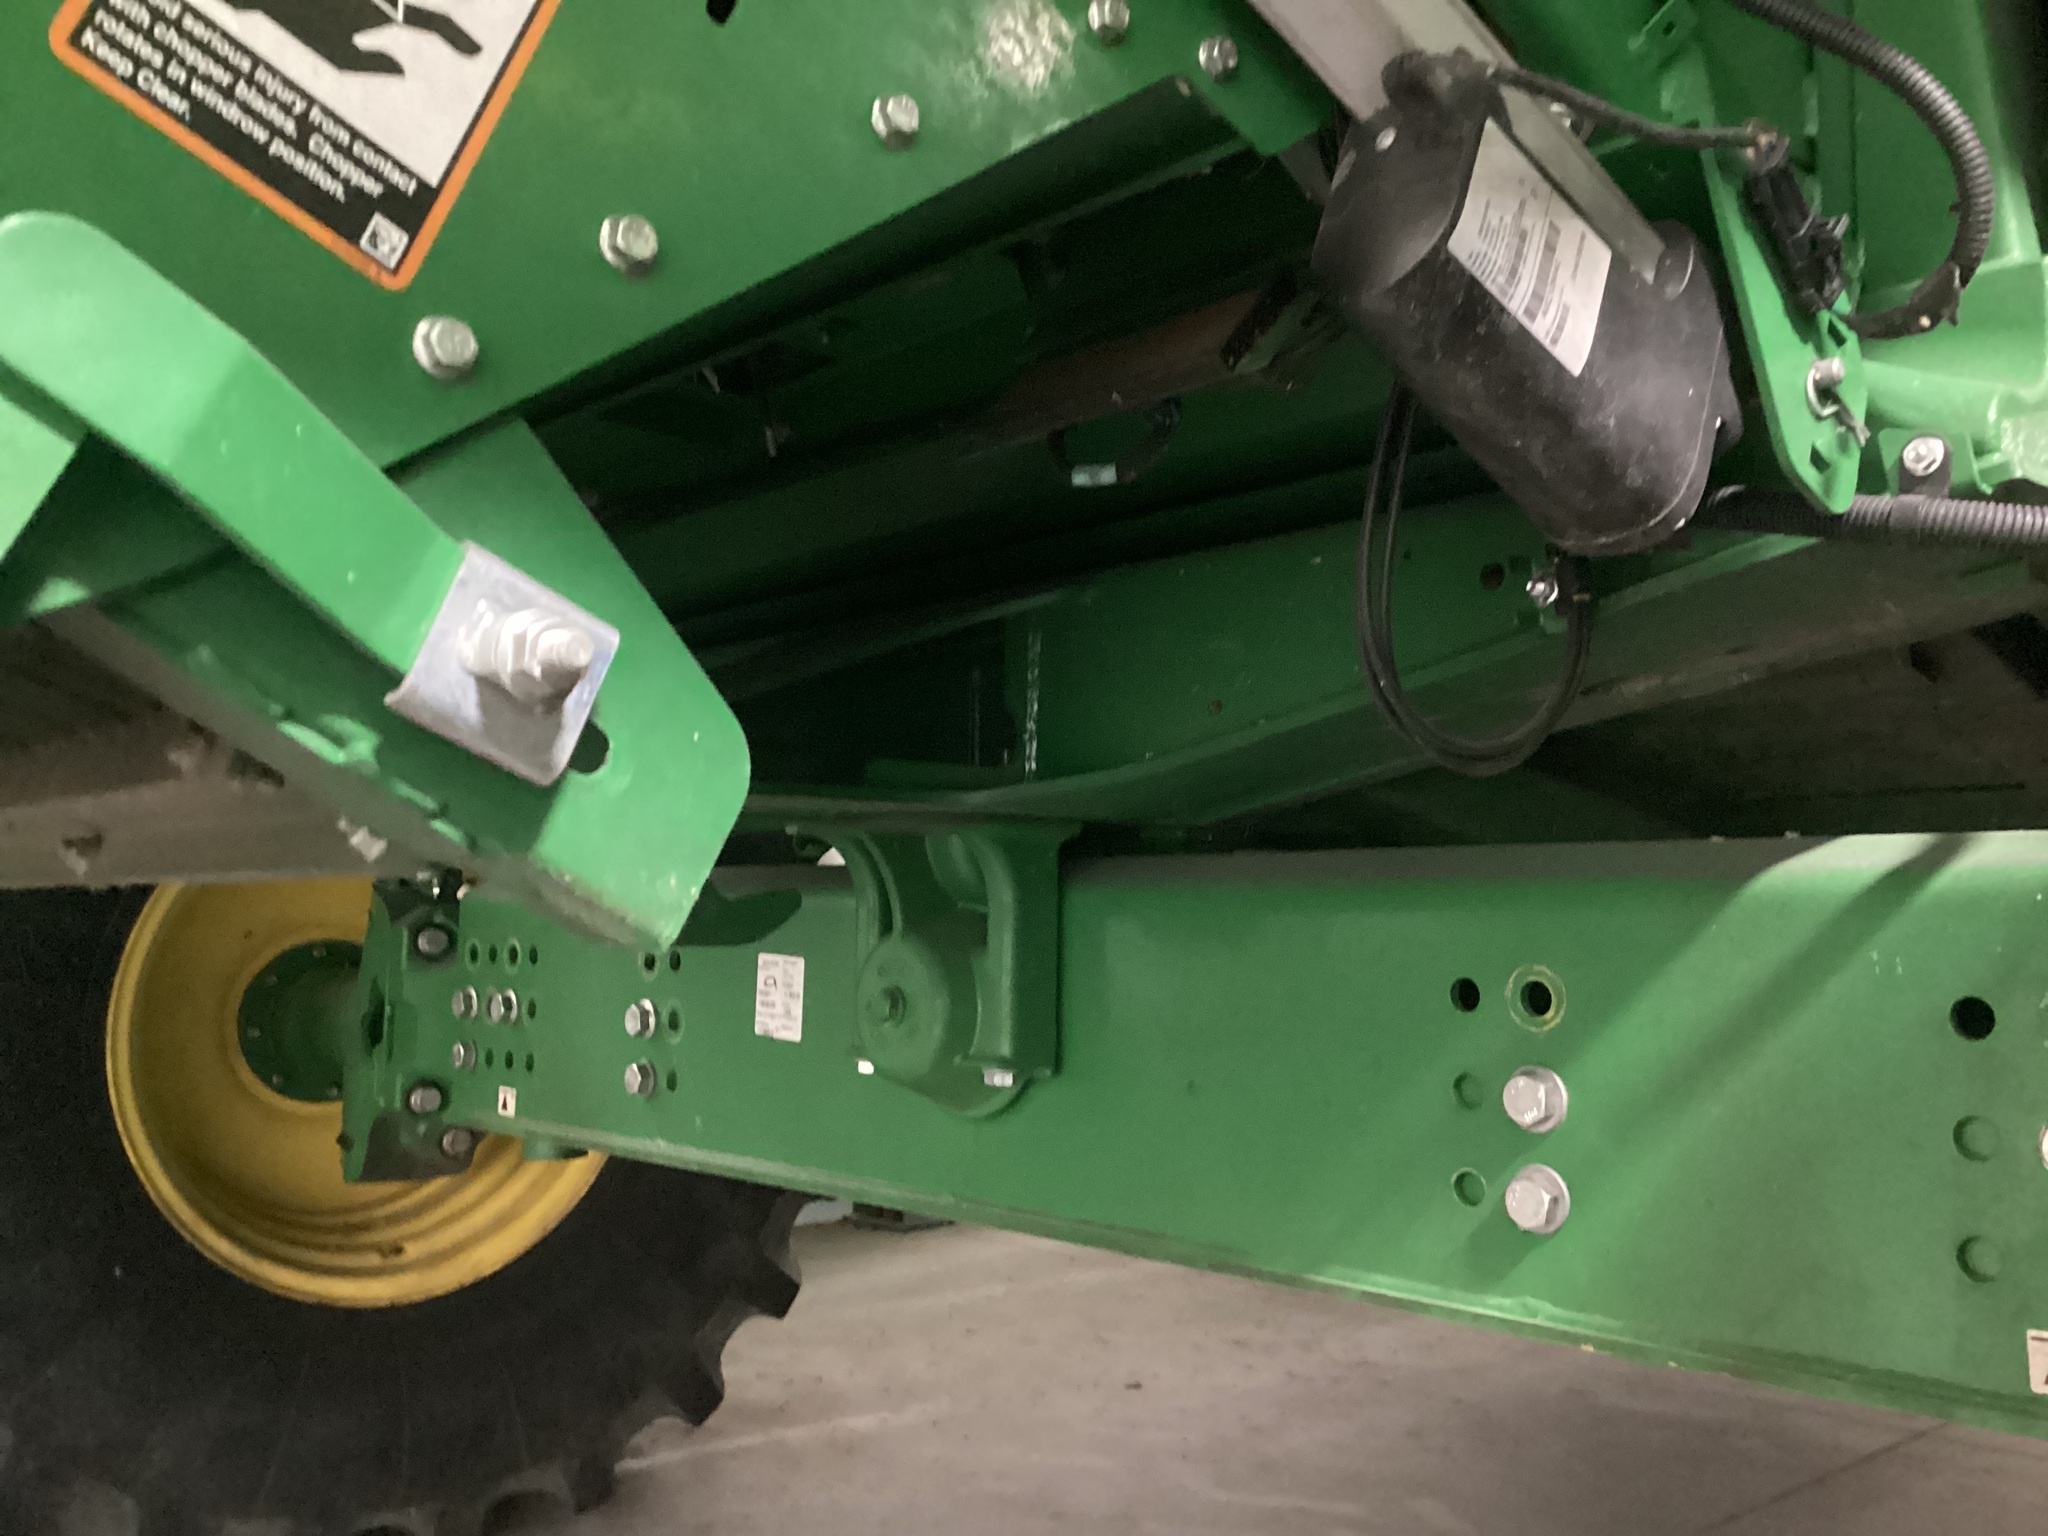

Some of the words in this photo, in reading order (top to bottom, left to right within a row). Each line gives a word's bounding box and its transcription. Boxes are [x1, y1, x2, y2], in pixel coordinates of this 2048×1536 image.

[80, 25, 134, 78] Keep
[94, 8, 164, 69] rotates
[167, 58, 186, 86] in
[190, 77, 270, 145] windrow
[269, 136, 345, 204] position.
[153, 20, 234, 88] chopper
[308, 132, 384, 199] Chopper
[182, 11, 252, 74] serious
[254, 64, 307, 116] injury
[308, 104, 351, 147] from
[352, 139, 417, 198] contact
